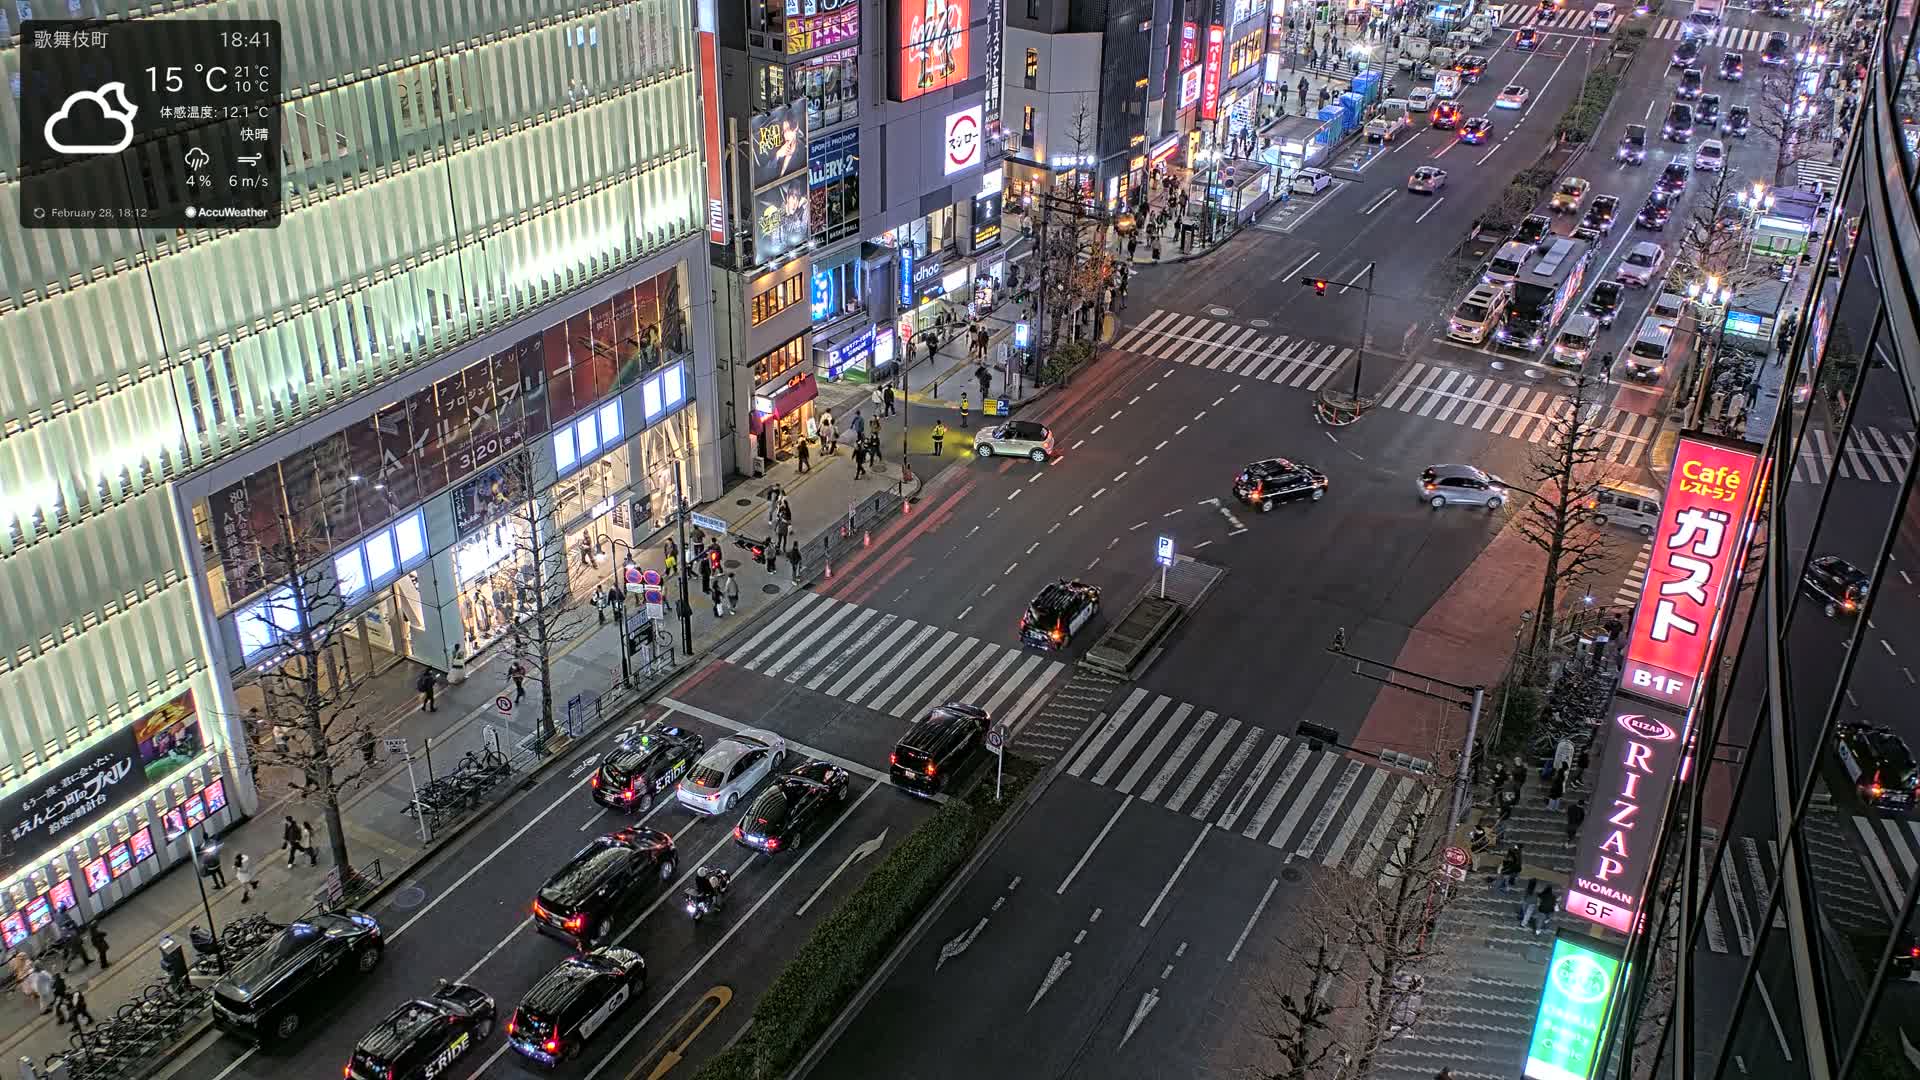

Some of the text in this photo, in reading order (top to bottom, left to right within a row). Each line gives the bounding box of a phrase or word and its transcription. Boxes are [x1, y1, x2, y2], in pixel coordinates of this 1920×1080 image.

[1205, 44, 1221, 109] バーガーキング
[948, 132, 979, 149] スシロー
[710, 199, 723, 232] MUJI
[829, 351, 839, 367] P
[446, 376, 503, 412] プロジェクト
[997, 400, 1005, 410] P
[459, 439, 499, 470] 3.20
[1682, 460, 1741, 489] Café
[1680, 480, 1737, 502] レストラン
[1651, 508, 1730, 641] ガスト
[1633, 669, 1684, 695] B1F
[1631, 719, 1663, 734] RIZAP
[22, 753, 115, 811] もう一度、君に会いたい
[655, 763, 686, 794] S.RIDE
[19, 756, 132, 836] えんとつ町のプペル
[1595, 740, 1654, 882] RIZAP
[48, 793, 108, 836] 約束の時計台
[1577, 877, 1633, 905] WOMAN
[1584, 901, 1614, 919] 5F
[424, 1039, 471, 1080] S.RIDE
